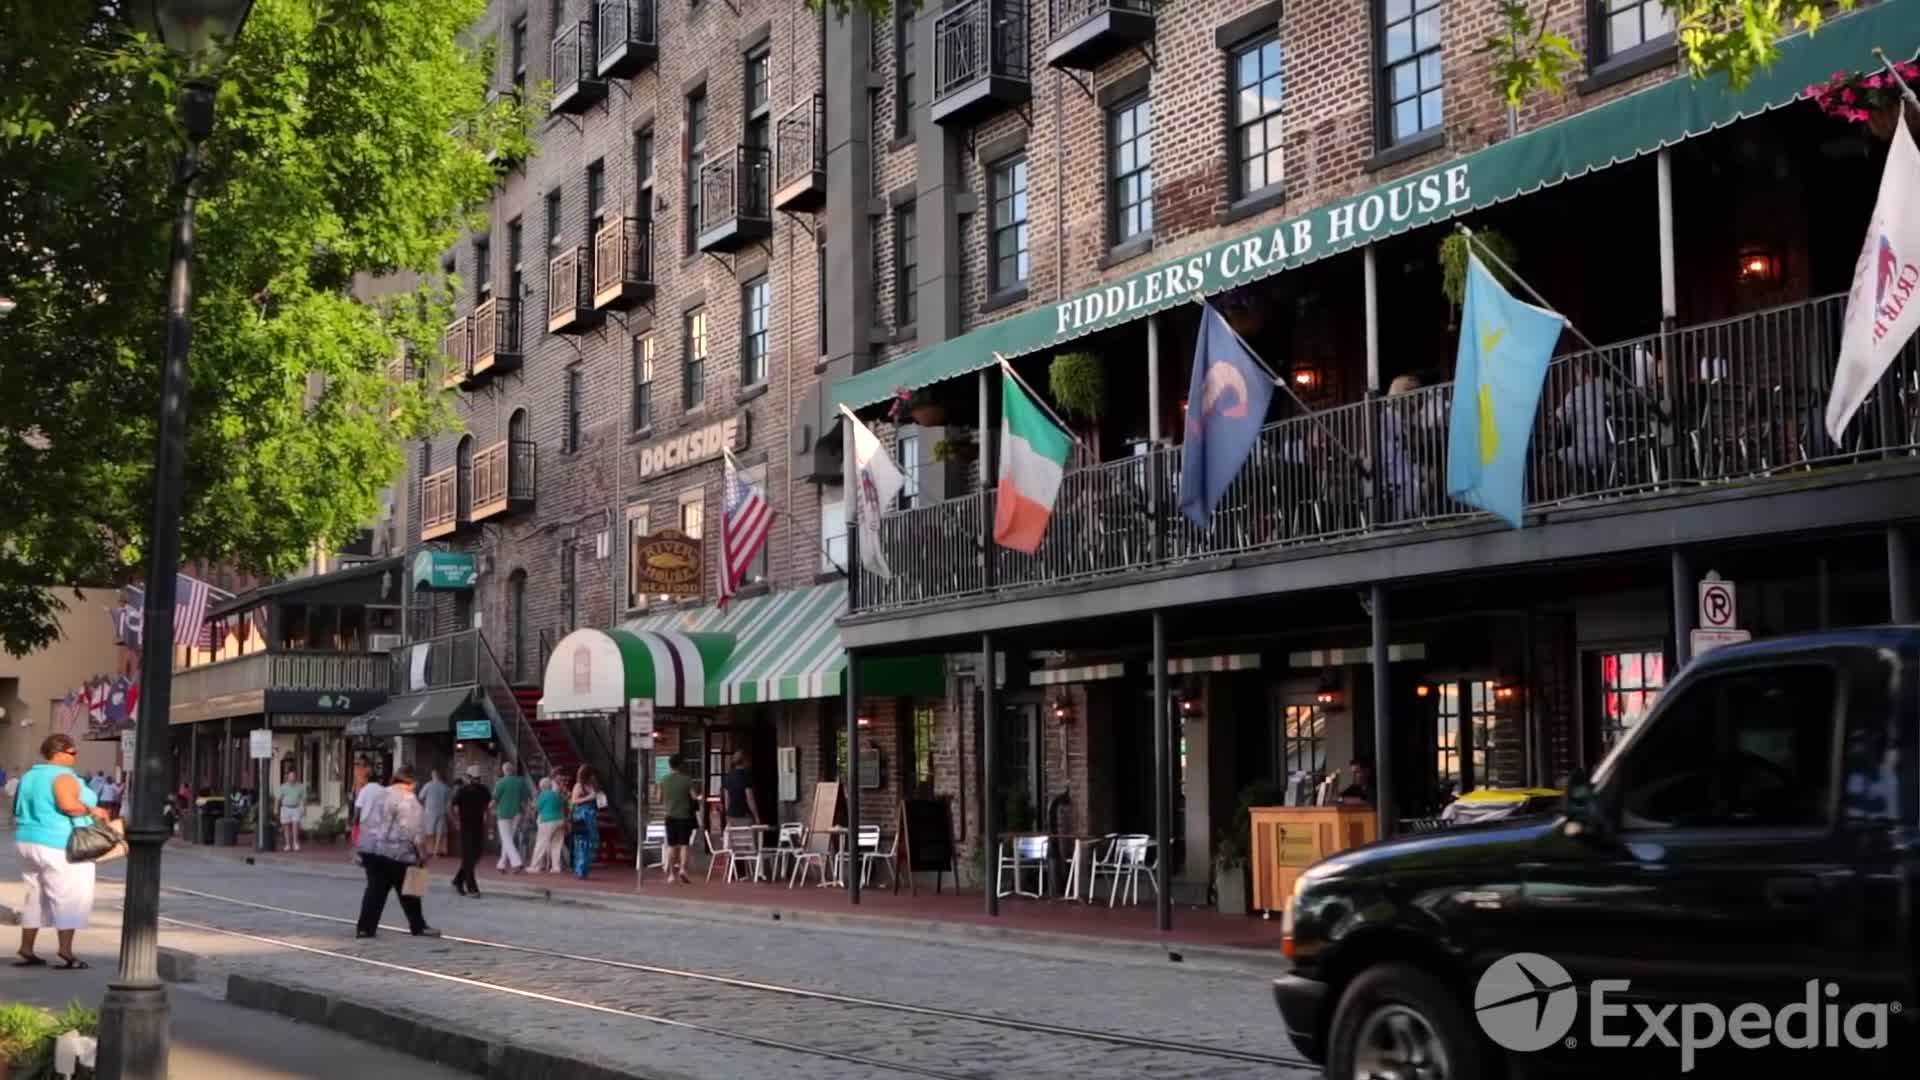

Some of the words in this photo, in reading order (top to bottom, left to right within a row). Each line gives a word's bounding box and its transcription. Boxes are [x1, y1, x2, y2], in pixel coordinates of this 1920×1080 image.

[1056, 252, 1211, 333] FIDDLERS'
[1220, 219, 1312, 279] CRAB
[1327, 163, 1471, 244] HOUSE
[640, 417, 737, 477] DOCKSIDE
